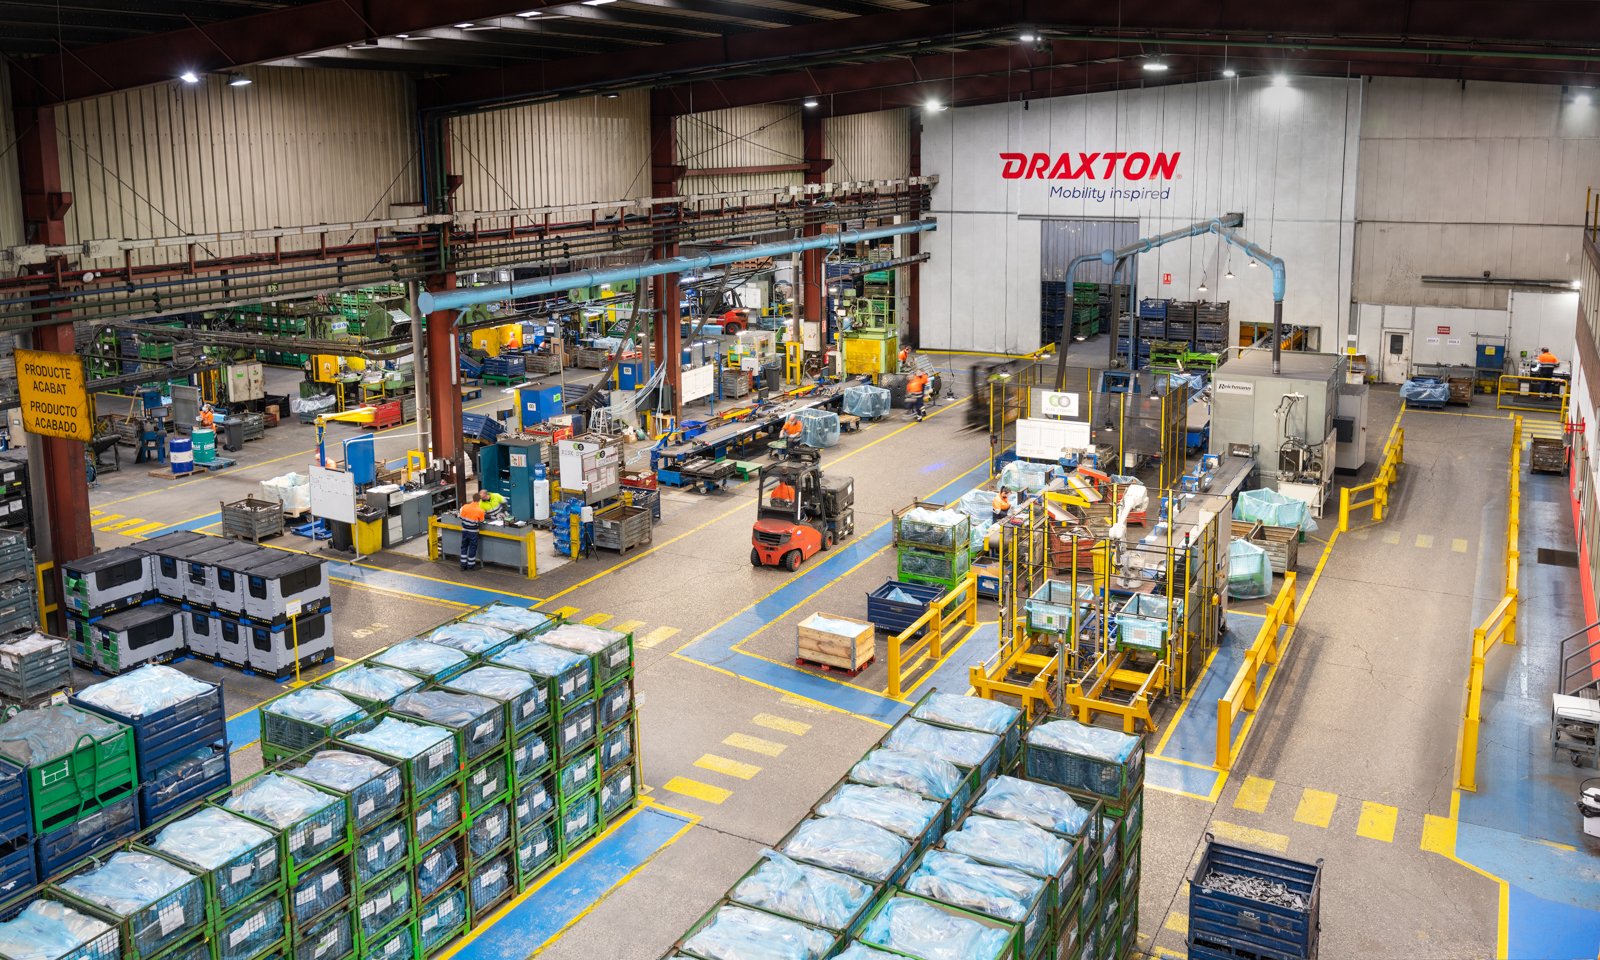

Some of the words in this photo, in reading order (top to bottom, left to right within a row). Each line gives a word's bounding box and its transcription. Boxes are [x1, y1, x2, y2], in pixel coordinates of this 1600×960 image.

[999, 152, 1181, 180] DRAXTON
[1049, 186, 1106, 202] Mobility
[1110, 187, 1171, 202] inspired
[24, 363, 72, 380] PRODUCTE
[33, 381, 67, 395] ACABAT
[30, 400, 78, 418] PRODUCTO
[34, 417, 77, 433] ACABADO
